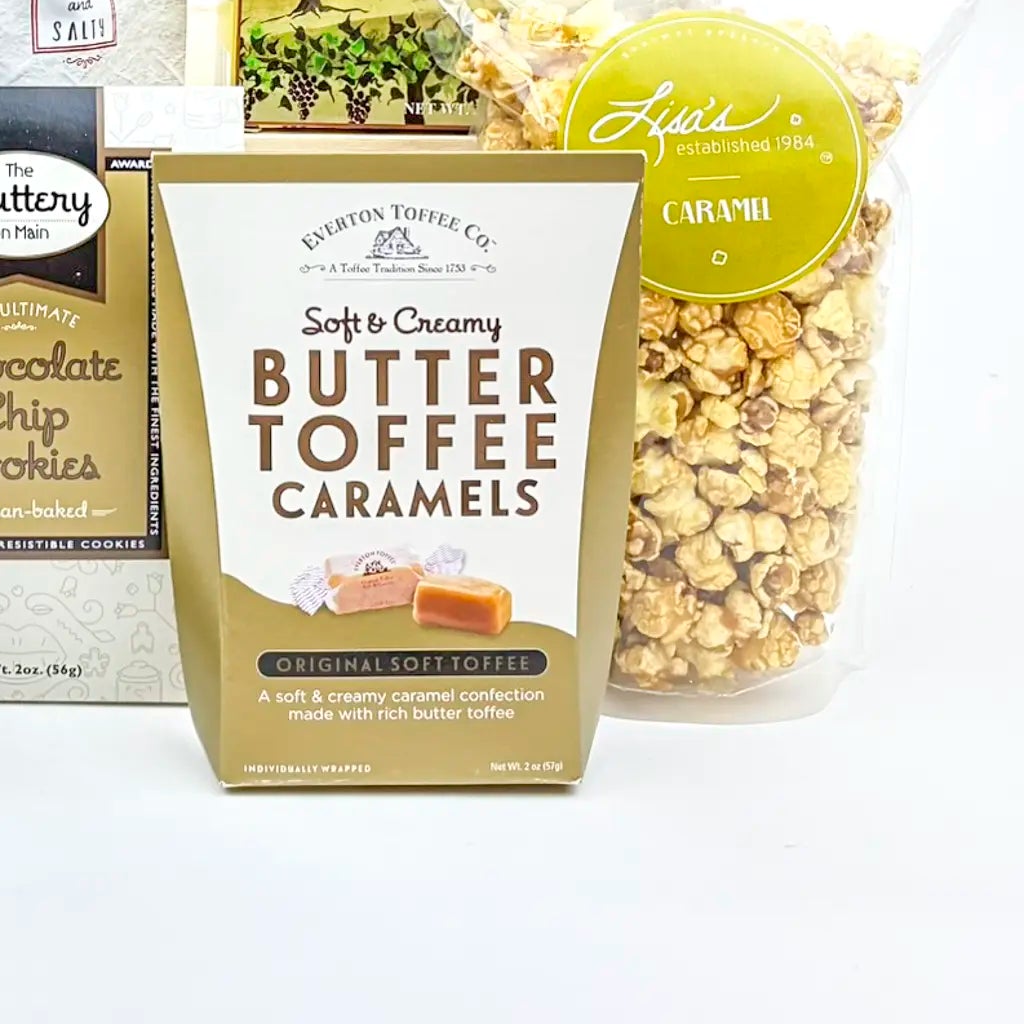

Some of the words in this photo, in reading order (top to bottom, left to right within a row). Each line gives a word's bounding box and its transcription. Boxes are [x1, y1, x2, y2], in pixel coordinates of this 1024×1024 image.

[51, 17, 106, 42] SALTY
[404, 102, 434, 116] NET
[440, 102, 470, 116] WT.
[676, 136, 771, 156] established
[775, 135, 815, 151] 1984
[5, 163, 34, 178] The
[662, 196, 772, 226] CARAMEL
[14, 224, 50, 240] Main
[300, 207, 385, 251] EVERTON
[391, 203, 461, 232] TOFFEE
[329, 264, 338, 273] A
[339, 263, 370, 274] Toffee
[372, 263, 415, 274] Tradition
[417, 264, 443, 274] Since
[445, 263, 466, 274] 1753
[0, 300, 81, 329] ULTIMATE
[301, 306, 363, 344] Soft
[367, 313, 387, 334] &
[393, 306, 502, 343] Creamy
[252, 347, 557, 407] BUTTER
[150, 407, 160, 449] FINEST
[248, 412, 557, 472] TOFFEE
[149, 453, 160, 536] INGREDIENTS
[271, 479, 540, 520] CARAMELS
[80, 539, 146, 550] COOKIES
[46, 662, 83, 677] (56g)
[275, 656, 384, 673] ORIGINAL
[389, 655, 445, 672] SOFT
[451, 655, 529, 672] TOFFEE
[258, 690, 270, 704] A
[275, 688, 307, 704] soft
[311, 690, 323, 704] &
[327, 690, 387, 707] creamy
[391, 688, 456, 703] caramel
[459, 687, 545, 702] confection
[288, 707, 334, 721] made
[338, 707, 373, 721] with
[377, 706, 408, 721] rich
[412, 706, 463, 720] butter
[466, 705, 516, 720] toffee
[243, 764, 318, 773] INDIVIDUALLY
[320, 764, 372, 773] WRAPPED
[490, 761, 506, 772] Net
[507, 761, 522, 772] Wt.
[523, 761, 530, 772] 2
[531, 763, 541, 772] oz
